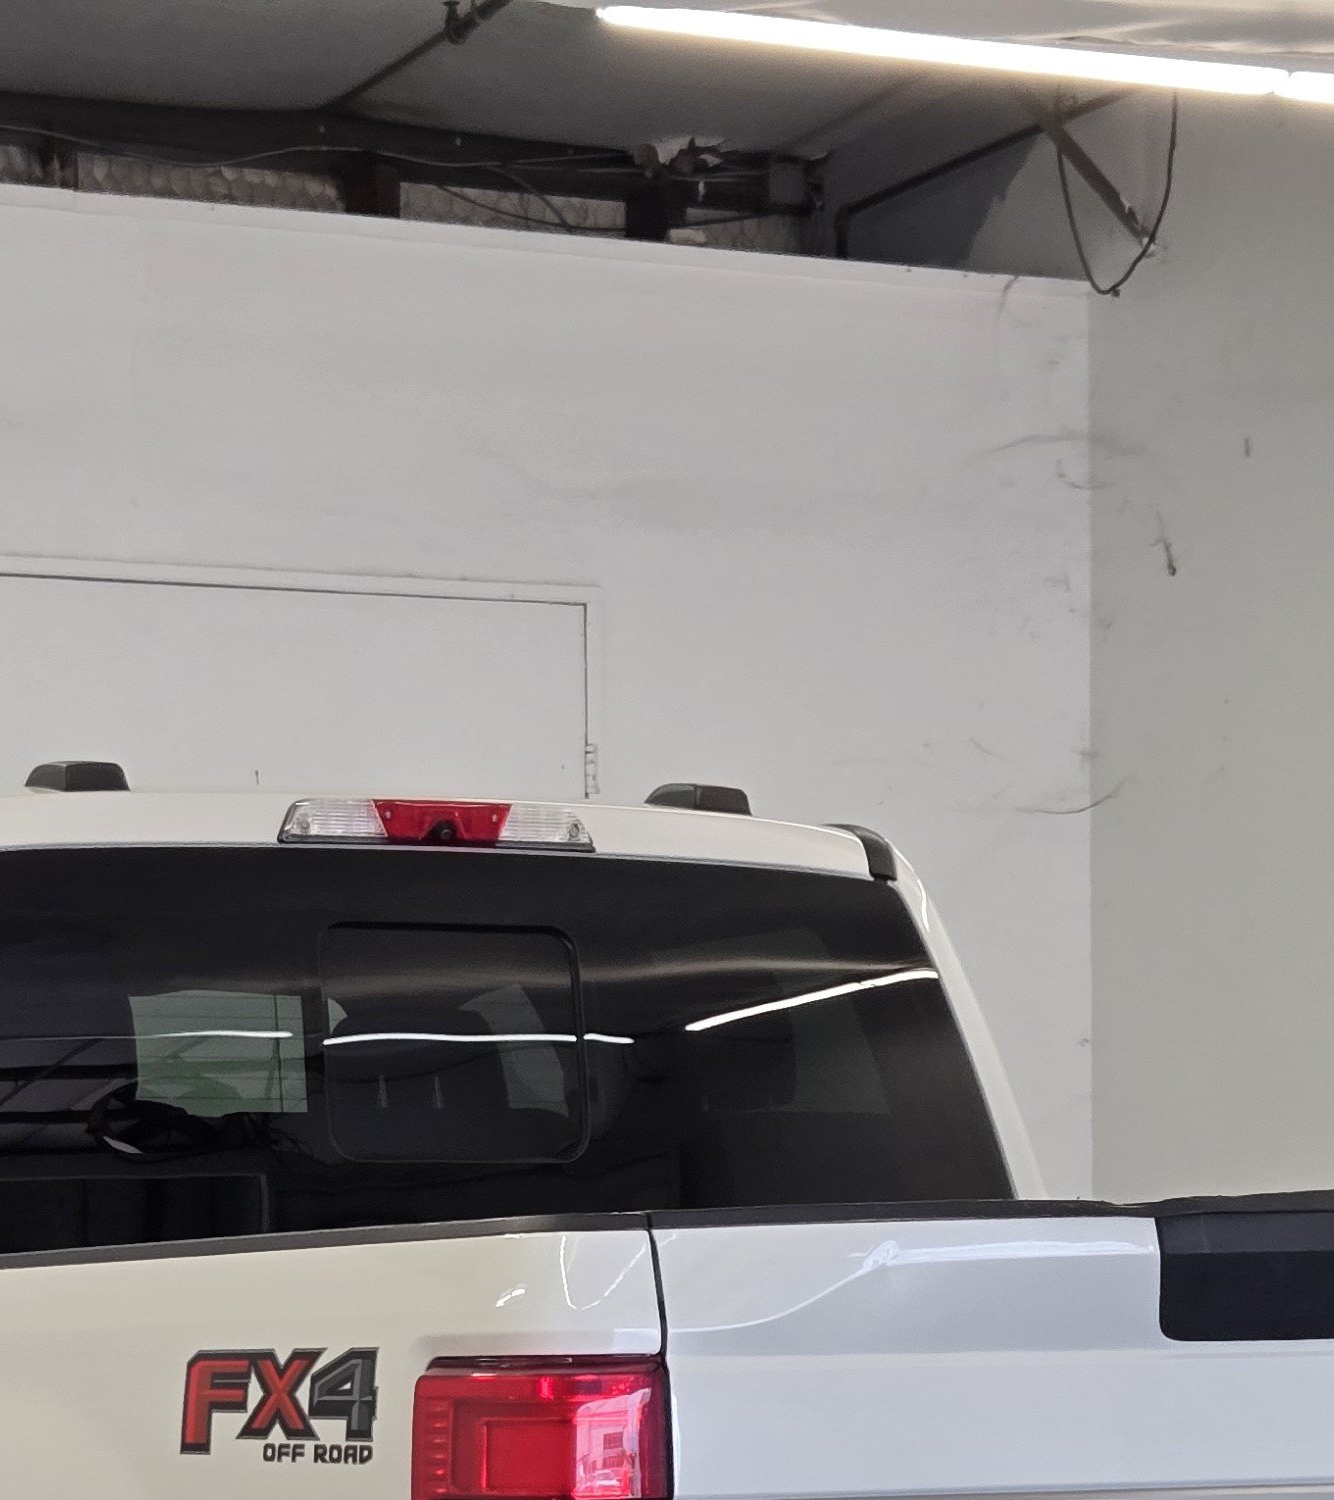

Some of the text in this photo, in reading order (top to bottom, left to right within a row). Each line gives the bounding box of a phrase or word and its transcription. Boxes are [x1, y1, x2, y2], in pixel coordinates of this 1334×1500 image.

[180, 1347, 379, 1455] FX4
[263, 1443, 373, 1464] OFF ROAD
